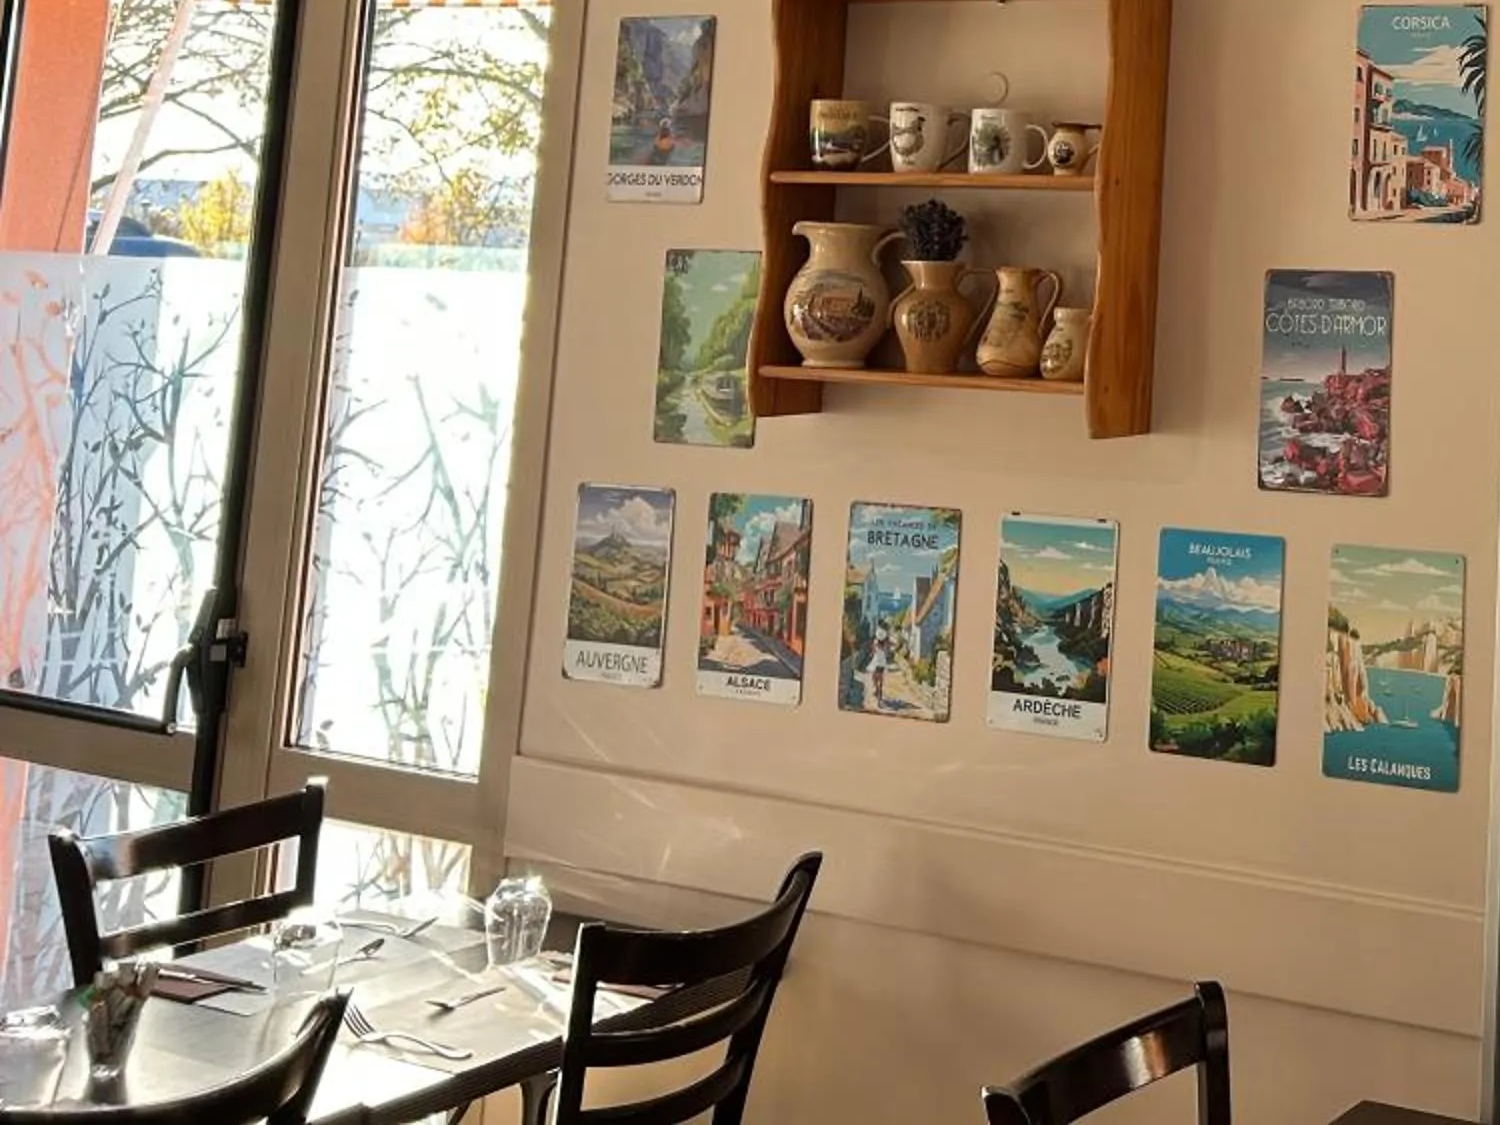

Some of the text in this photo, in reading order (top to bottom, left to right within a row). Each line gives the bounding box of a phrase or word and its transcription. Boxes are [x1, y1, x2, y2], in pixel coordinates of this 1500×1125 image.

[1391, 16, 1451, 31] CORSICA
[867, 530, 939, 550] BRETAGNE
[1189, 542, 1252, 559] BEAUJOLAIS
[576, 650, 648, 674] AUVERGNE
[726, 676, 771, 691] ALSACE
[1347, 755, 1431, 780] LES CALANQUES
